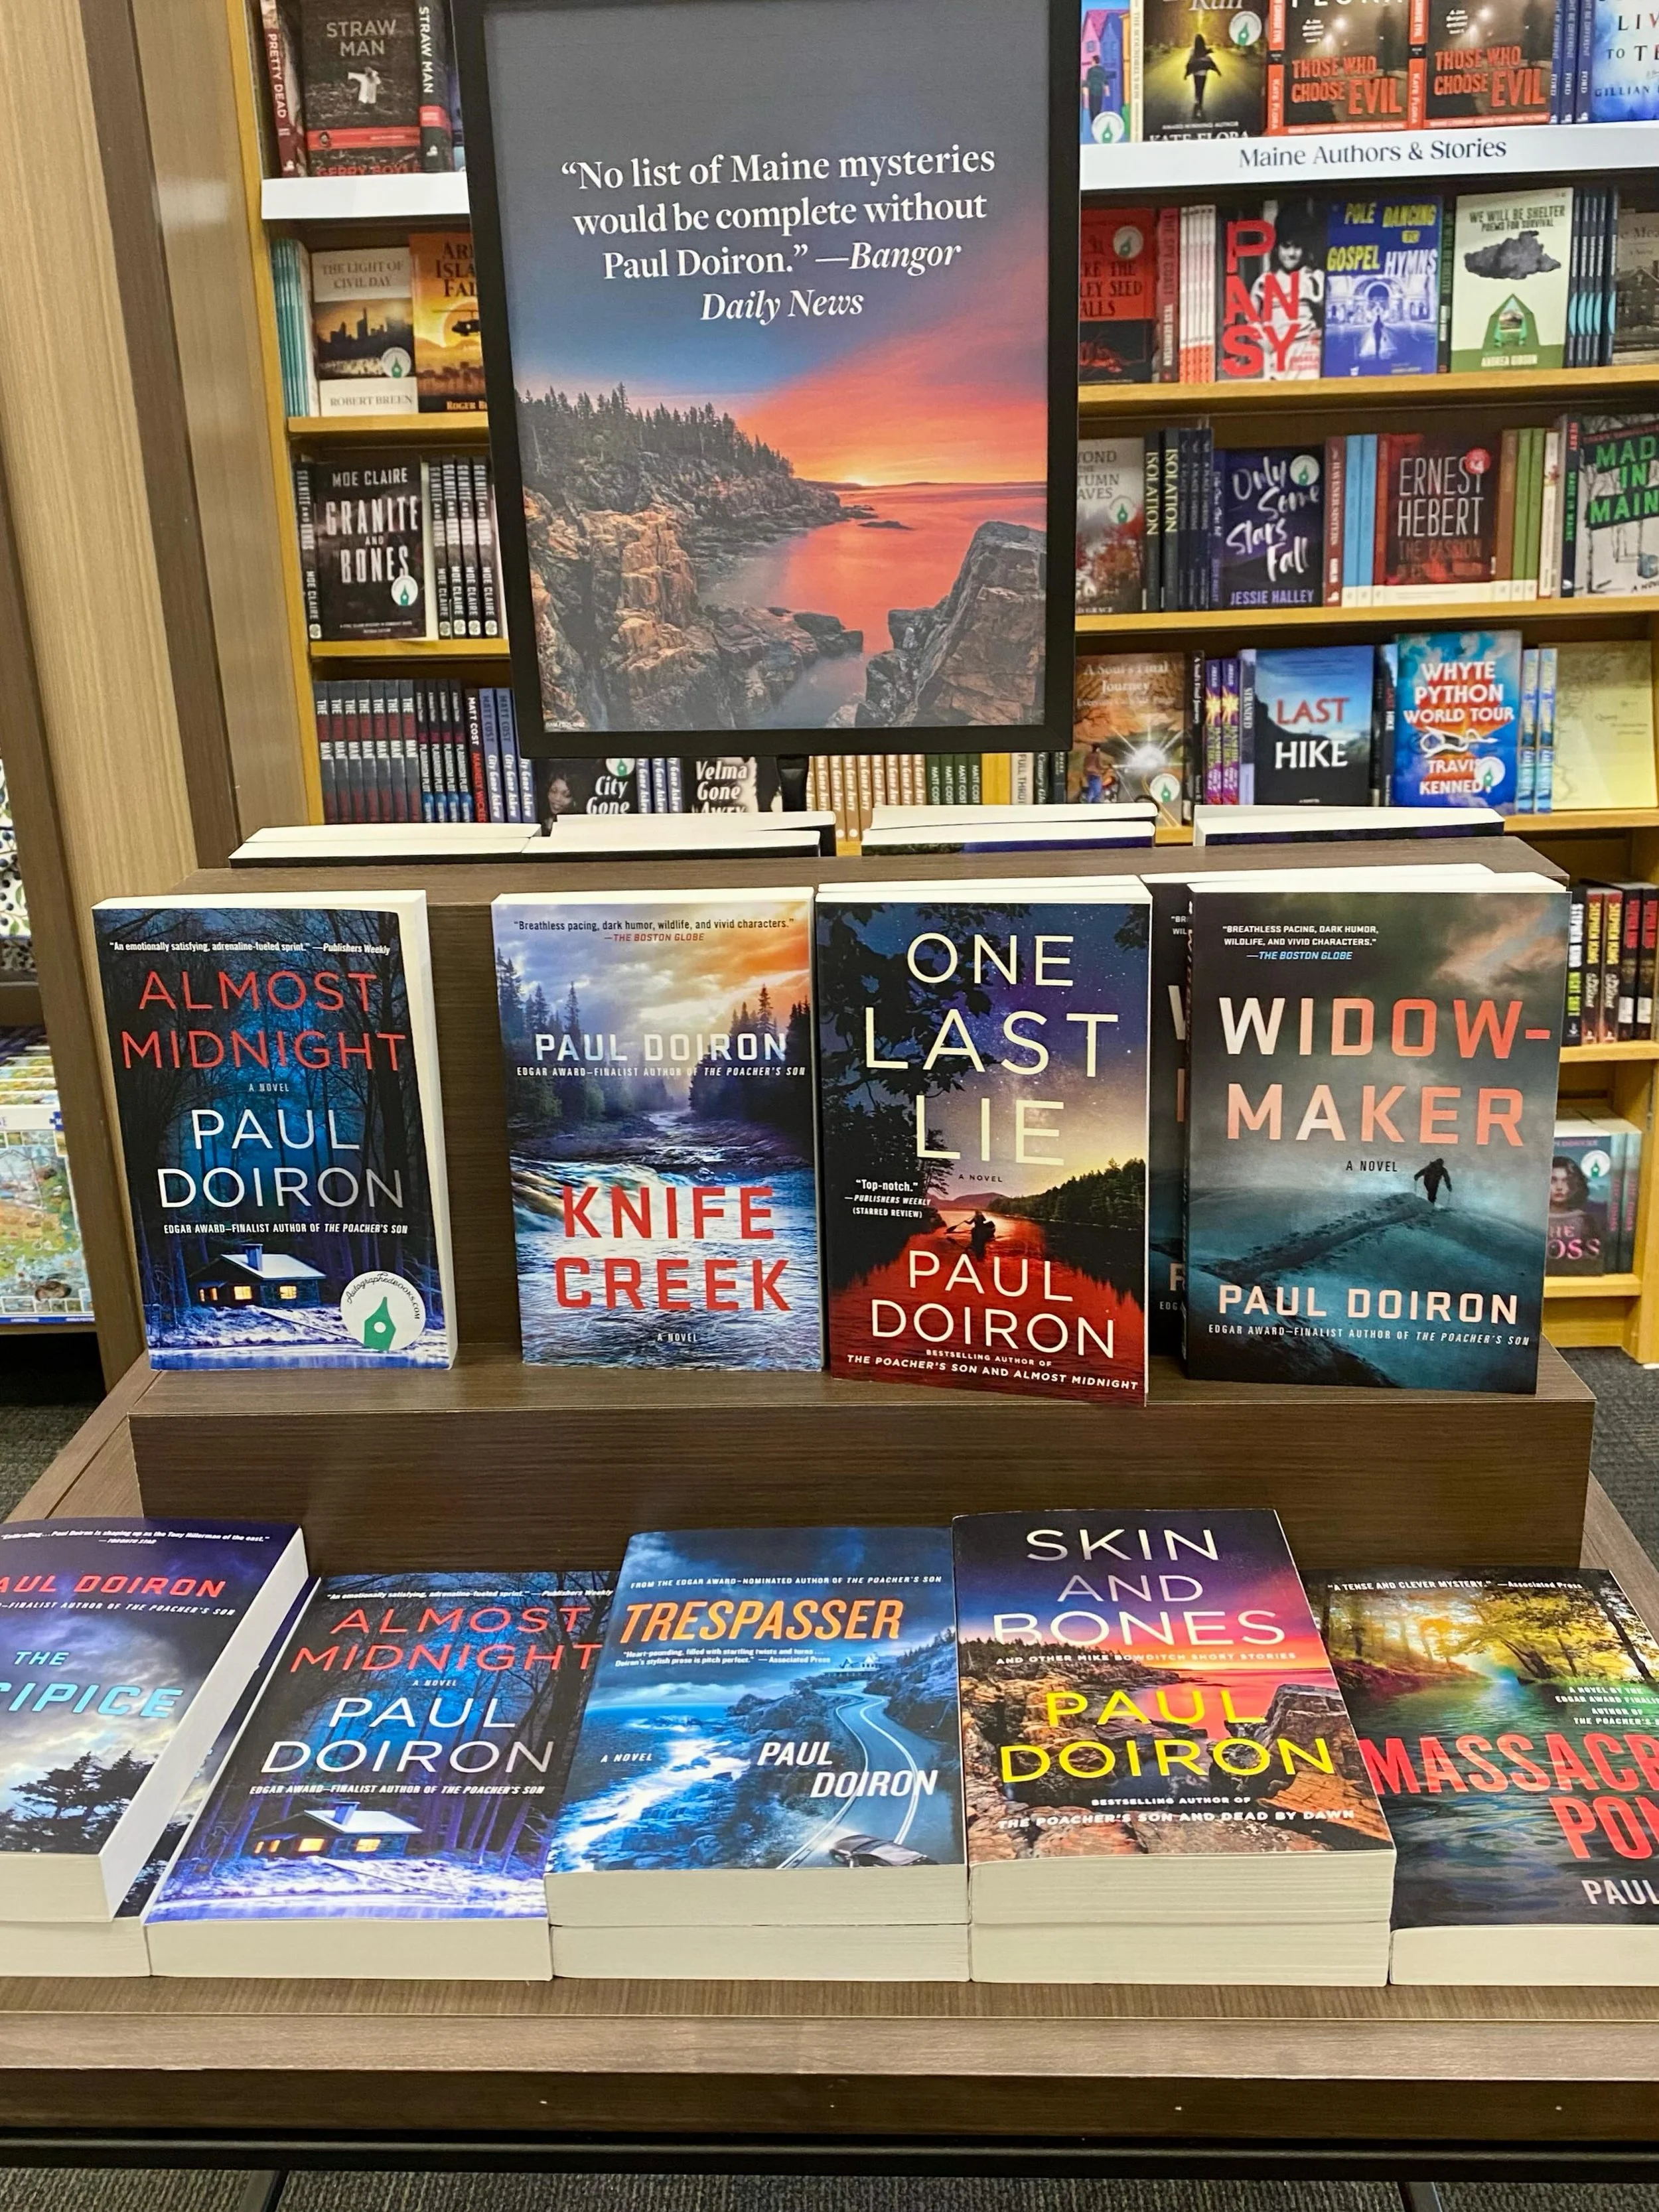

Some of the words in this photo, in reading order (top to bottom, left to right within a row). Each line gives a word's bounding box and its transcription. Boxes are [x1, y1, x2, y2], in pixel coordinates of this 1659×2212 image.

[326, 19, 396, 38] STRAW
[419, 6, 432, 56] STRAW
[267, 34, 282, 80] PRETTY
[340, 40, 385, 56] MAN
[1435, 49, 1484, 71] THOSE
[1486, 46, 1521, 68] WHO
[422, 61, 433, 93] MAN
[1292, 58, 1338, 79] THOSE
[1343, 56, 1376, 76] WHO
[273, 84, 287, 119] DEAD
[1291, 82, 1345, 103] CHOOSE
[1348, 78, 1403, 115] EVIL
[1434, 74, 1490, 96] CHOOSE
[1491, 68, 1546, 108] EVIL
[632, 159, 681, 188] list
[689, 155, 723, 185] of
[731, 152, 829, 183] Maine
[839, 145, 995, 187] mysteries
[1239, 147, 1306, 168] Maine
[1313, 143, 1400, 166] Authors
[1409, 142, 1423, 160] &
[1431, 138, 1506, 159] Stories
[572, 204, 668, 236] would
[673, 202, 709, 232] be
[715, 197, 857, 236] complete
[863, 192, 987, 223] without
[1344, 203, 1377, 224] POLE
[1469, 212, 1484, 223] WE
[1487, 210, 1509, 222] WILL
[1513, 208, 1524, 220] BE
[1527, 205, 1565, 219] SHELTER
[1507, 220, 1519, 230] FOR
[1522, 219, 1553, 230] SURVIVAL
[322, 265, 344, 275] THE
[348, 262, 385, 273] LIGHT
[389, 261, 403, 271] OF
[603, 250, 668, 280] Paul
[1327, 245, 1380, 271] GOSPEL
[1385, 249, 1438, 277] HYMNS
[334, 277, 366, 289] CIVIL
[368, 276, 392, 287] DAY
[701, 291, 780, 325] Daily
[788, 289, 864, 317] News
[330, 396, 374, 406] ROBERT
[1596, 436, 1656, 471] MAD
[332, 471, 358, 487] MOE
[365, 467, 407, 485] CLAIRE
[1232, 456, 1287, 500] Only
[1619, 463, 1650, 488] IN
[1146, 452, 1159, 535] ISOLATION
[1165, 449, 1179, 533] ISOLATION
[1257, 484, 1319, 519] Some
[325, 495, 418, 536] GRANITE
[1397, 496, 1484, 538] HEBERT
[365, 536, 384, 545] AND
[1226, 518, 1287, 555] Stars
[340, 546, 409, 583] BONES
[1267, 536, 1309, 581] Fall
[1230, 591, 1267, 606] JESSIE
[1271, 589, 1315, 604] HALLEY
[1421, 661, 1496, 682] WHYTE
[1414, 684, 1504, 705] PYTHON
[1276, 697, 1350, 725] LAST
[1403, 707, 1465, 725] WORLD
[1470, 706, 1514, 722] TOUR
[470, 722, 479, 745] COST
[1275, 739, 1348, 769] HIKE
[695, 761, 747, 780] Velma
[596, 775, 628, 798] City
[697, 780, 741, 801] Gone
[587, 798, 630, 814] Gone
[568, 921, 600, 932] pacing,
[603, 920, 622, 930] dark
[625, 920, 655, 931] humor,
[658, 919, 691, 930] wildlife,
[695, 919, 711, 929] and
[713, 919, 735, 928] vivid
[634, 933, 672, 942] BOSTON
[674, 933, 704, 942] GLOBE
[125, 943, 169, 953] emotionally
[212, 942, 280, 952] adrenaline-fueled
[364, 944, 390, 955] Weekly
[907, 932, 1074, 986] ONE
[139, 970, 377, 1011] ALMOST
[865, 1007, 1119, 1077] LAST
[1219, 997, 1551, 1059] WIDOW-
[121, 1030, 406, 1071] MIDNIGHT
[535, 1033, 628, 1062] PAUL
[644, 1033, 786, 1061] DOIRON
[259, 1084, 289, 1092] NOVEL
[191, 1108, 360, 1150] PAUL
[916, 1094, 1064, 1165] LIE
[1228, 1082, 1524, 1147] MAKER
[157, 1167, 403, 1209] DOIRON
[902, 1197, 931, 1206] WEEKLY
[562, 1185, 774, 1240] KNIFE
[853, 1207, 888, 1217] (STARRED
[891, 1208, 922, 1218] REVIEW)
[164, 1224, 192, 1234] EDGAR
[273, 1223, 306, 1233] AUTHOR
[309, 1223, 320, 1232] OF
[324, 1223, 340, 1232] THE
[391, 1224, 408, 1234] SON
[554, 1256, 792, 1311] CREEK
[909, 1250, 1073, 1302] PAUL
[1219, 1285, 1327, 1317] PAUL
[1348, 1288, 1518, 1325] DOIRON
[871, 1299, 1114, 1359] DOIRON
[1027, 1528, 1218, 1562] SKIN
[1056, 1574, 1203, 1603] AND
[1342, 1582, 1373, 1591] TENSE
[1376, 1581, 1396, 1590] AND
[1398, 1580, 1436, 1589] CLEVER
[1557, 1582, 1583, 1590] Press
[330, 1607, 591, 1634] ALMOST
[619, 1599, 904, 1643] TRESPASSER
[993, 1609, 1285, 1647] BONES
[14, 1651, 69, 1666] THE
[291, 1643, 603, 1672] MIDNIGHT
[328, 1697, 516, 1728] PAUL
[1045, 1689, 1265, 1727] PAUL
[261, 1740, 554, 1774] DOIRON
[757, 1741, 833, 1767] PAUL
[999, 1737, 1336, 1783] DOIRON
[810, 1770, 938, 1798] DOIRON
